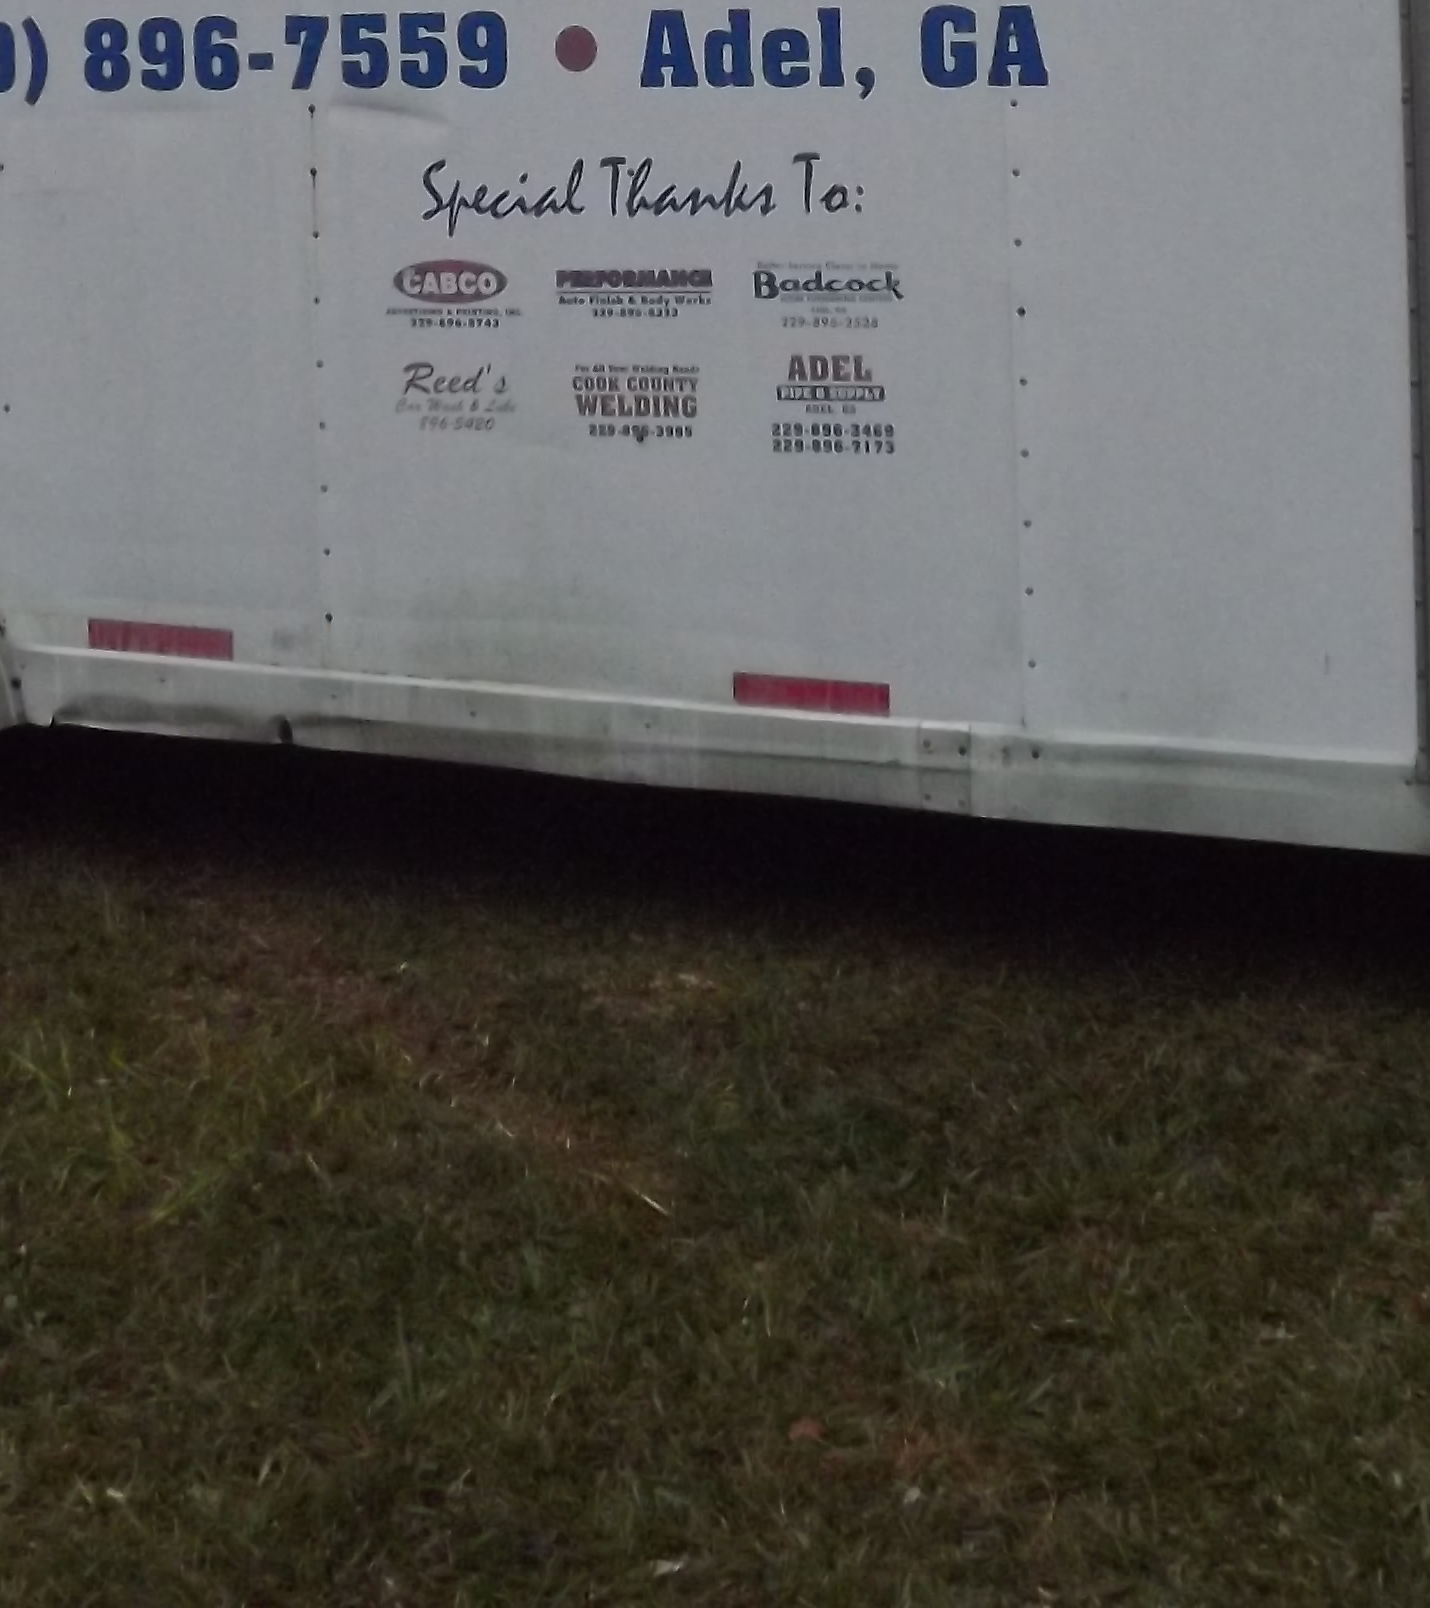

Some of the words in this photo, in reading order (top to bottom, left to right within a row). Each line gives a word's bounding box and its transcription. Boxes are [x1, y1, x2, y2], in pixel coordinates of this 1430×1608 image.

[84, 9, 509, 93] 896-7559
[639, 7, 876, 101] Adel,
[920, 5, 1049, 89] GA
[421, 159, 586, 238] Special
[599, 155, 778, 219] Thanks
[792, 152, 866, 215] To:
[402, 265, 498, 295] CABCO
[555, 269, 714, 288] PERFORMANCE
[753, 270, 905, 301] Badcock
[403, 362, 510, 396] Reed's
[787, 354, 874, 382] ADEL
[572, 375, 620, 392] COOK
[626, 375, 699, 393] COUNTY
[574, 394, 698, 418] WELDING
